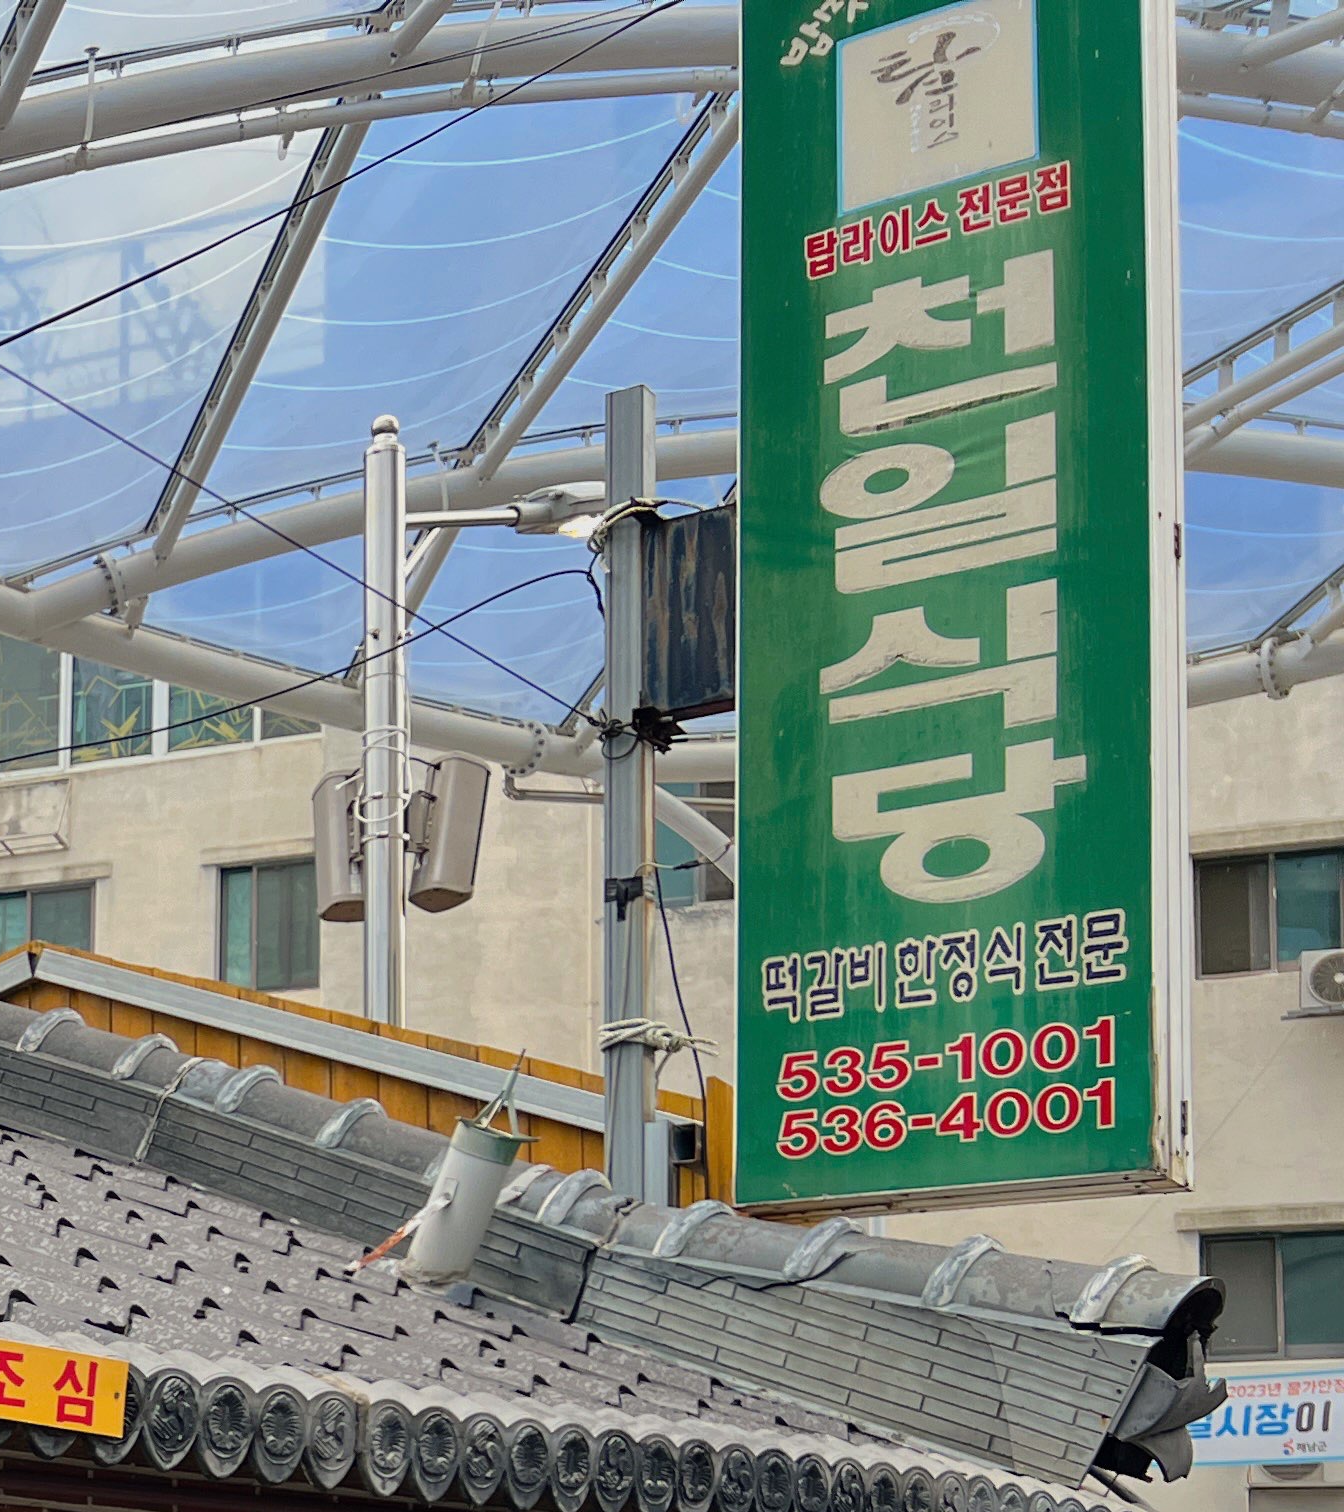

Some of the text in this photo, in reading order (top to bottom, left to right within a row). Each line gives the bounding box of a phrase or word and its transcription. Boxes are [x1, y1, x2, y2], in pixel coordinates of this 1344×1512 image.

[803, 160, 1071, 281] 탑라이스 전문점
[818, 248, 1088, 904] 천일식당
[761, 907, 1130, 1023] 떡갈비 한정식 전문
[775, 1014, 1117, 1101] 535-1001
[775, 1077, 1117, 1160] 536-4001
[1227, 1382, 1282, 1399] 2023년
